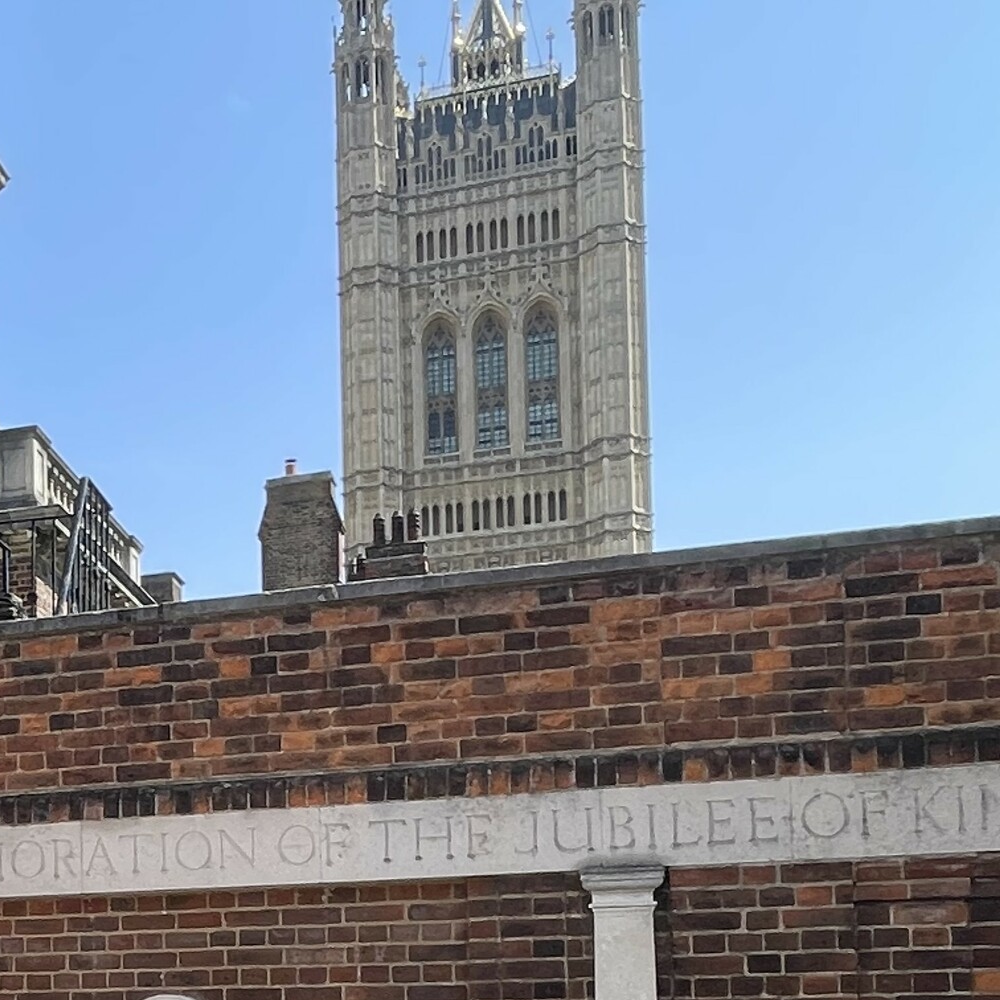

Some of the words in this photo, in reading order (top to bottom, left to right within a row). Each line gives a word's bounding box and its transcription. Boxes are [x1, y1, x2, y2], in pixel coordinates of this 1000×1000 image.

[277, 823, 350, 867] OF
[368, 813, 492, 864] THE
[514, 796, 779, 857] JUBILEE
[801, 789, 889, 839] OF
